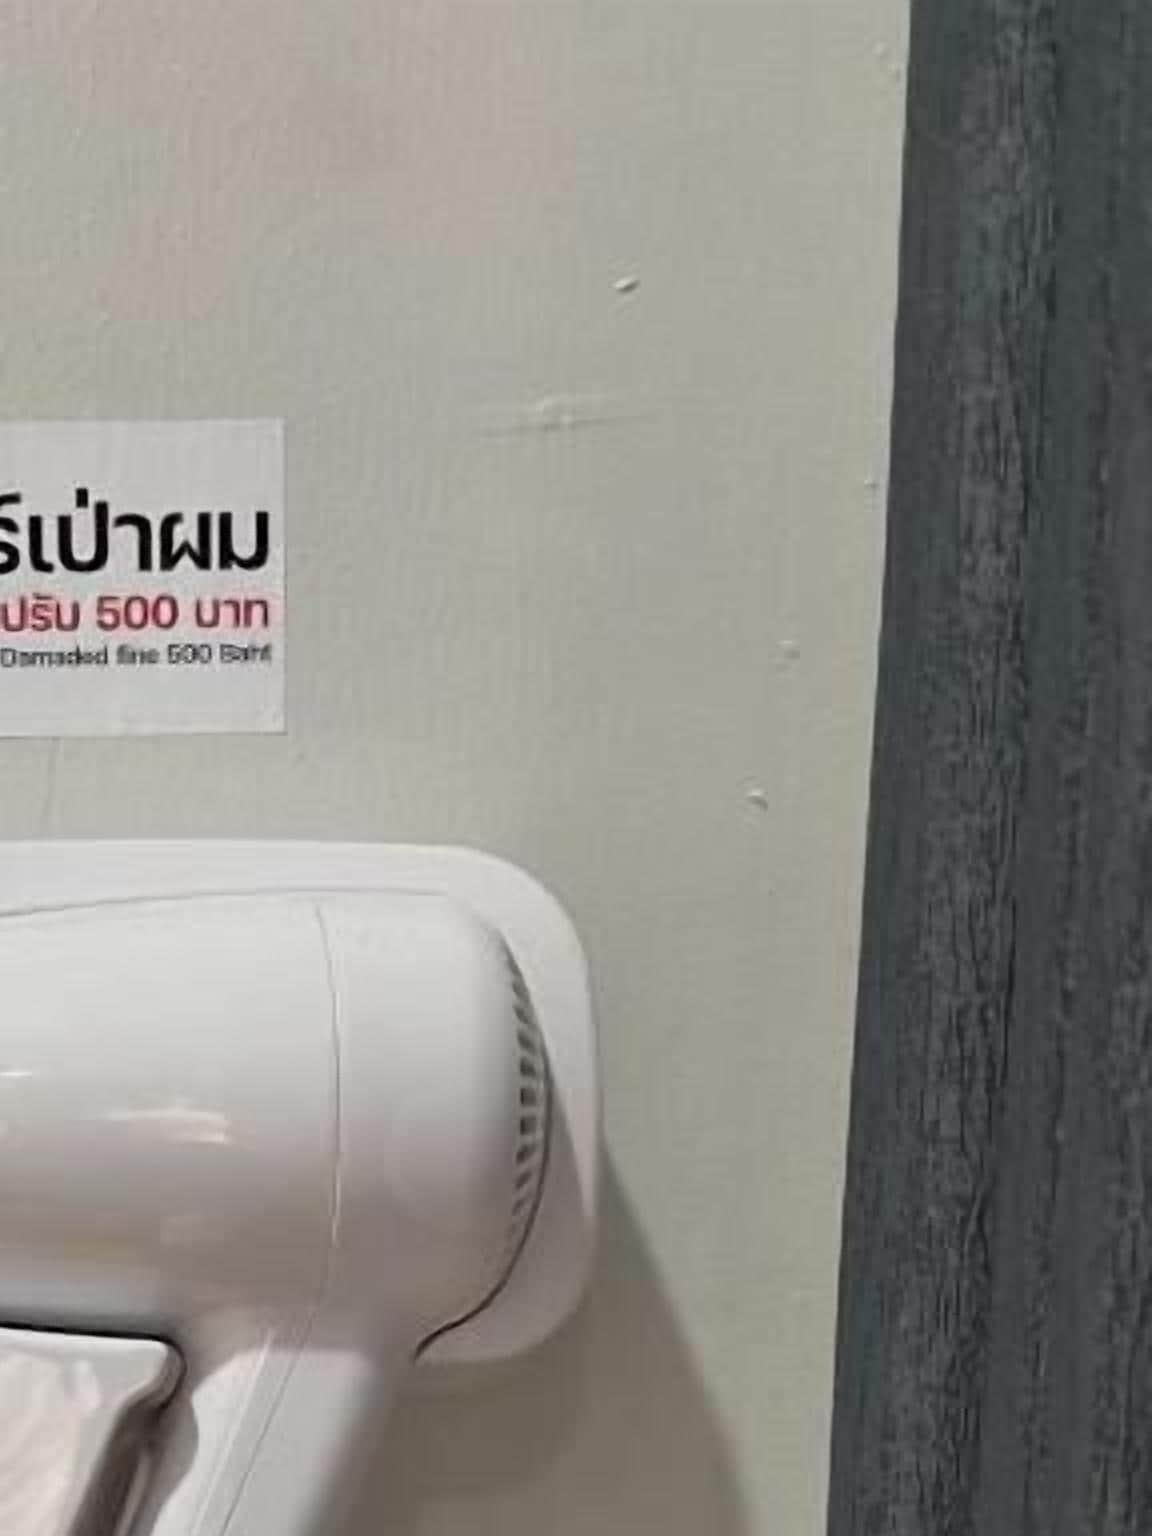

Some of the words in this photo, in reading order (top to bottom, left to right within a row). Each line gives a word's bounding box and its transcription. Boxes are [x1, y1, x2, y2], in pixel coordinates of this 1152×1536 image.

[96, 594, 179, 631] 500
[195, 598, 269, 628] บาท
[117, 644, 160, 665] fine
[168, 643, 212, 665] 500
